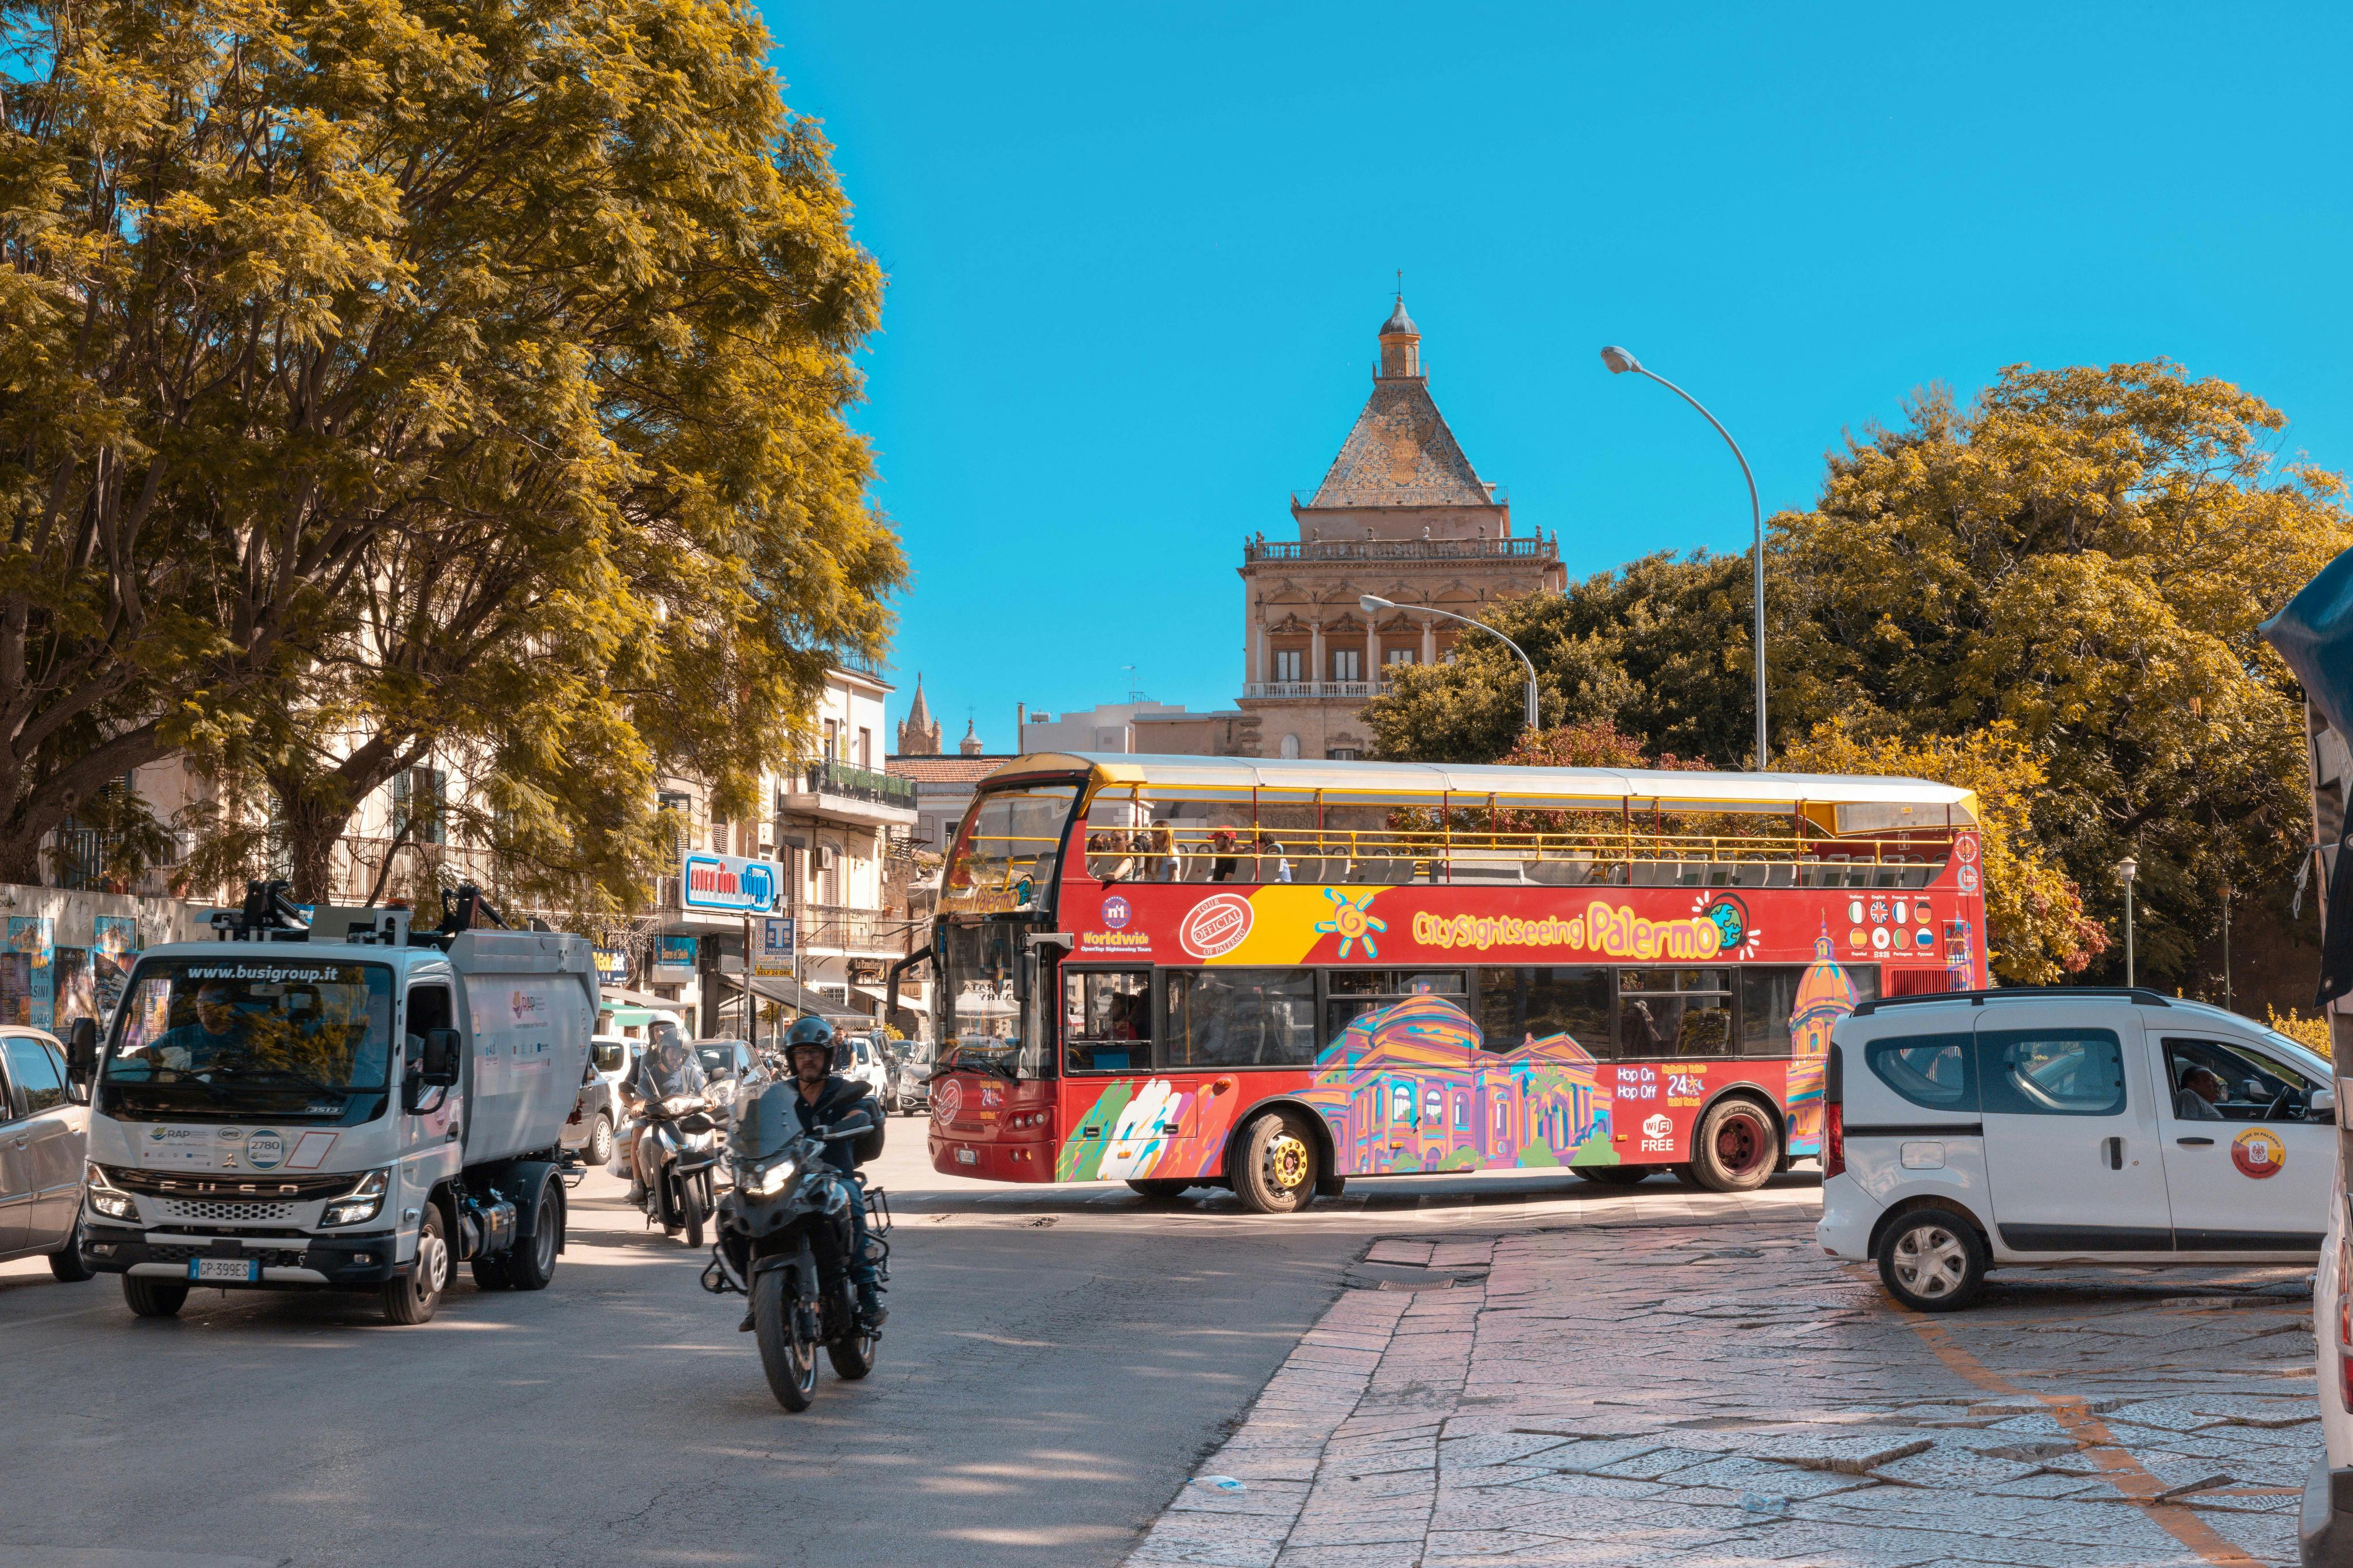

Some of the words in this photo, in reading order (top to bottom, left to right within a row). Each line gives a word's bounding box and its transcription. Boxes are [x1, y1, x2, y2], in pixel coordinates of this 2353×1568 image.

[1963, 872, 1978, 882] bmc
[974, 887, 1020, 912] Palermo
[1196, 898, 1220, 915] TOUR
[1194, 910, 1241, 941] OFFICIAL
[1587, 902, 1720, 959] Palermo
[1083, 930, 1149, 945] Worldwide
[1203, 947, 1214, 955] OF
[1215, 928, 1246, 954] PALERMO
[855, 959, 861, 969] La
[188, 965, 338, 983] www.busigroup.it
[31, 1014, 50, 1025] LUGLIO
[1617, 1068, 1638, 1083] Hop
[1640, 1067, 1655, 1081] On
[1617, 1085, 1638, 1099] Hop
[1640, 1084, 1657, 1099] Off
[1668, 1075, 1687, 1096] 24
[1667, 1097, 1683, 1107] Valid
[167, 1129, 190, 1138] RAP
[2260, 1131, 2281, 1148] PALERMO
[251, 1141, 280, 1150] 2780
[1641, 1139, 1674, 1152] FREE
[159, 1180, 299, 1196] FUSO
